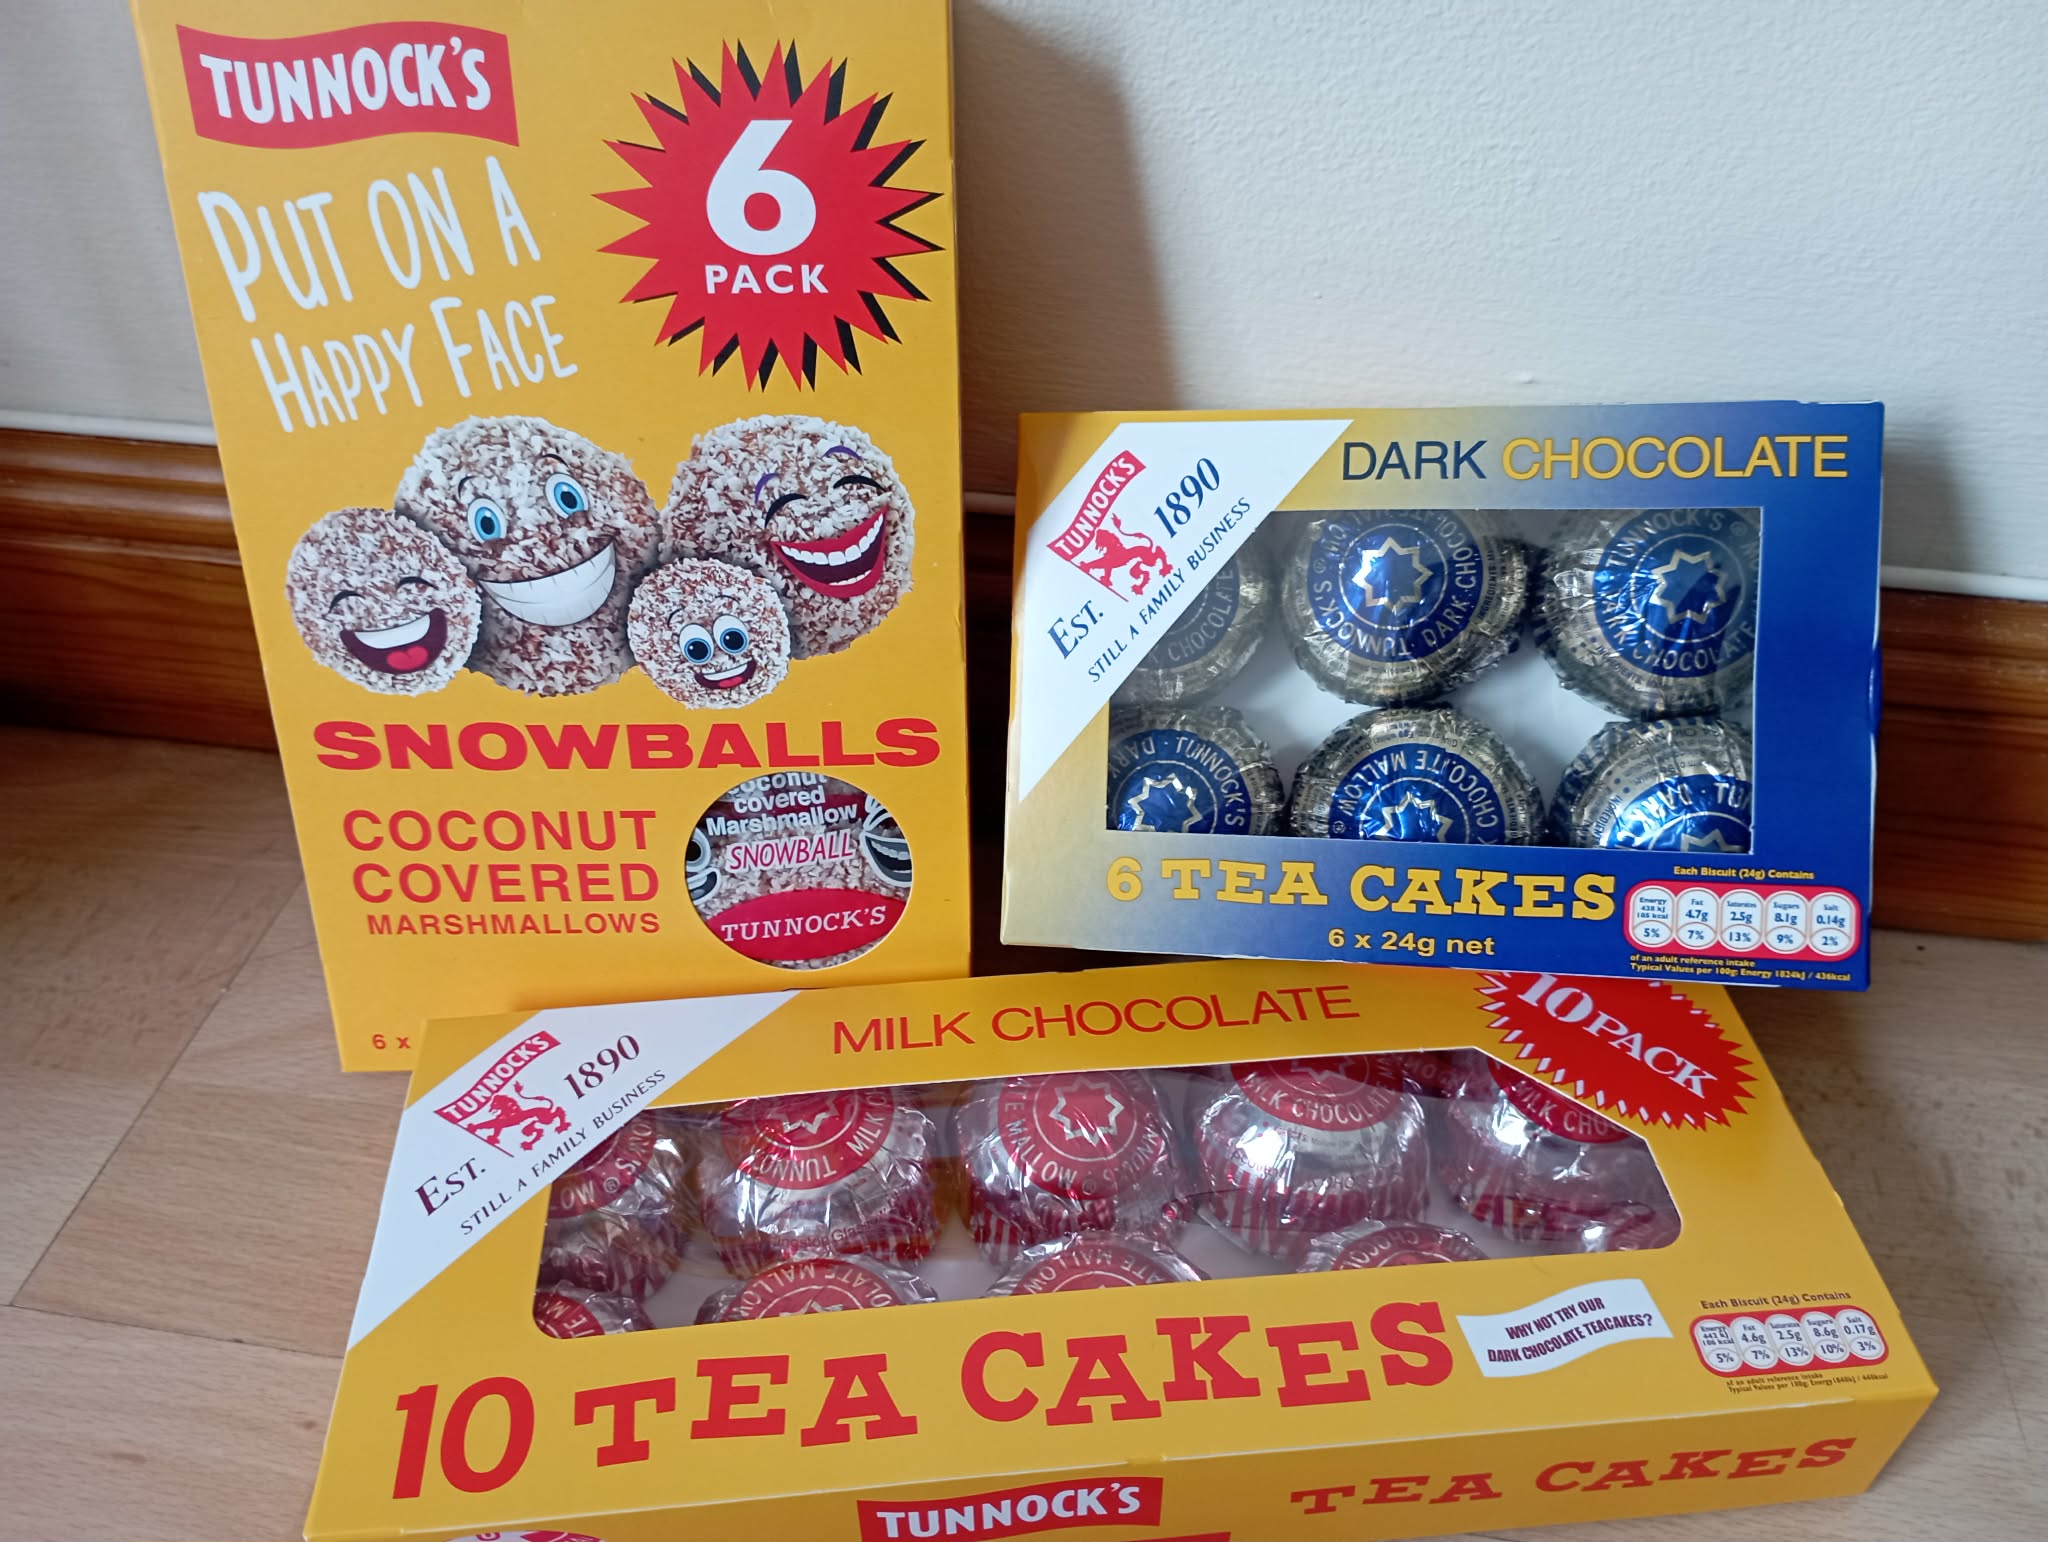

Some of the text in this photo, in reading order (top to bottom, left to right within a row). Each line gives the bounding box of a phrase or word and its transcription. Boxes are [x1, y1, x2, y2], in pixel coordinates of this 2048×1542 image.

[200, 37, 492, 125] TUNNOCK'S
[706, 119, 817, 256] 6
[198, 155, 542, 323] PUT ON A
[705, 264, 829, 295] PACK
[251, 295, 578, 433] HAPPY FACE
[1343, 435, 1850, 481] DARK CHOCOLATE
[1055, 457, 1137, 554] TUNNOCK'S
[1153, 457, 1222, 540] 1890
[1087, 639, 1128, 682] STILL
[1129, 624, 1140, 641] A
[1138, 567, 1186, 625] FAMILY
[1186, 497, 1251, 571] BUSINESS
[314, 717, 941, 771] SNOWBALLS
[733, 785, 826, 814] covered
[343, 809, 656, 852] COCONUT
[705, 802, 859, 837] Marshmallow
[728, 830, 854, 870] SNOWBALL
[352, 862, 659, 904] COVERED
[1674, 866, 1814, 880] Each Biscuit (24g) Contains
[1106, 857, 1617, 921] 6 TEA CAKES
[367, 913, 661, 937] MARSHMALLOWS
[720, 905, 887, 943] TUNNOCK'S
[1685, 909, 1709, 922] 4.7g
[1730, 911, 1753, 924] 2.5g
[1774, 913, 1798, 925] 8.1g
[1816, 915, 1845, 928] 0.14g
[1328, 929, 1495, 958] 6 x 24g net
[1643, 928, 1660, 938] 5%
[1687, 930, 1705, 940] 7%
[1728, 932, 1751, 942] 13%
[1776, 934, 1794, 945] 9%
[1821, 936, 1839, 946] 2%
[1630, 954, 1639, 962] of
[1654, 955, 1678, 963] adult
[1680, 956, 1724, 966] reference
[1725, 958, 1756, 967] intake
[1630, 962, 1663, 973] Typical
[1665, 964, 1694, 974] Values
[1696, 967, 1712, 975] per
[1740, 969, 1772, 979] Energy
[833, 984, 1361, 1055] MILK CHOCOLATE
[372, 1034, 411, 1051] 6 x
[1517, 973, 1718, 1099] 10 PACK
[441, 1035, 551, 1122] TUNNOCK'S
[562, 1034, 641, 1100] 1890
[460, 1190, 513, 1236] STILL
[515, 1176, 529, 1192] A
[531, 1128, 588, 1179] FAMILY
[592, 1068, 667, 1131] BUSINESS
[1700, 1291, 1851, 1310] Each Biscuit (24g) Contains
[1505, 1297, 1605, 1340] WHY NOT TRY OUR
[1813, 1326, 1839, 1339] 8.6g
[1487, 1313, 1653, 1363] DARK CHOCOLATE TEACAKES?
[1741, 1333, 1767, 1345] 4.6g
[1776, 1329, 1802, 1341] 2.5g
[1820, 1343, 1845, 1354] 10%
[1858, 1341, 1877, 1352] 3%
[1716, 1352, 1735, 1363] 5%
[1751, 1349, 1771, 1360] 7%
[1785, 1346, 1809, 1358] 13%
[1767, 1375, 1799, 1384] reference
[392, 1300, 1455, 1500] 10 TEA CAKES
[1291, 1437, 1857, 1516] TEA CAKES
[876, 1483, 1141, 1538] TUNNOCK'S
